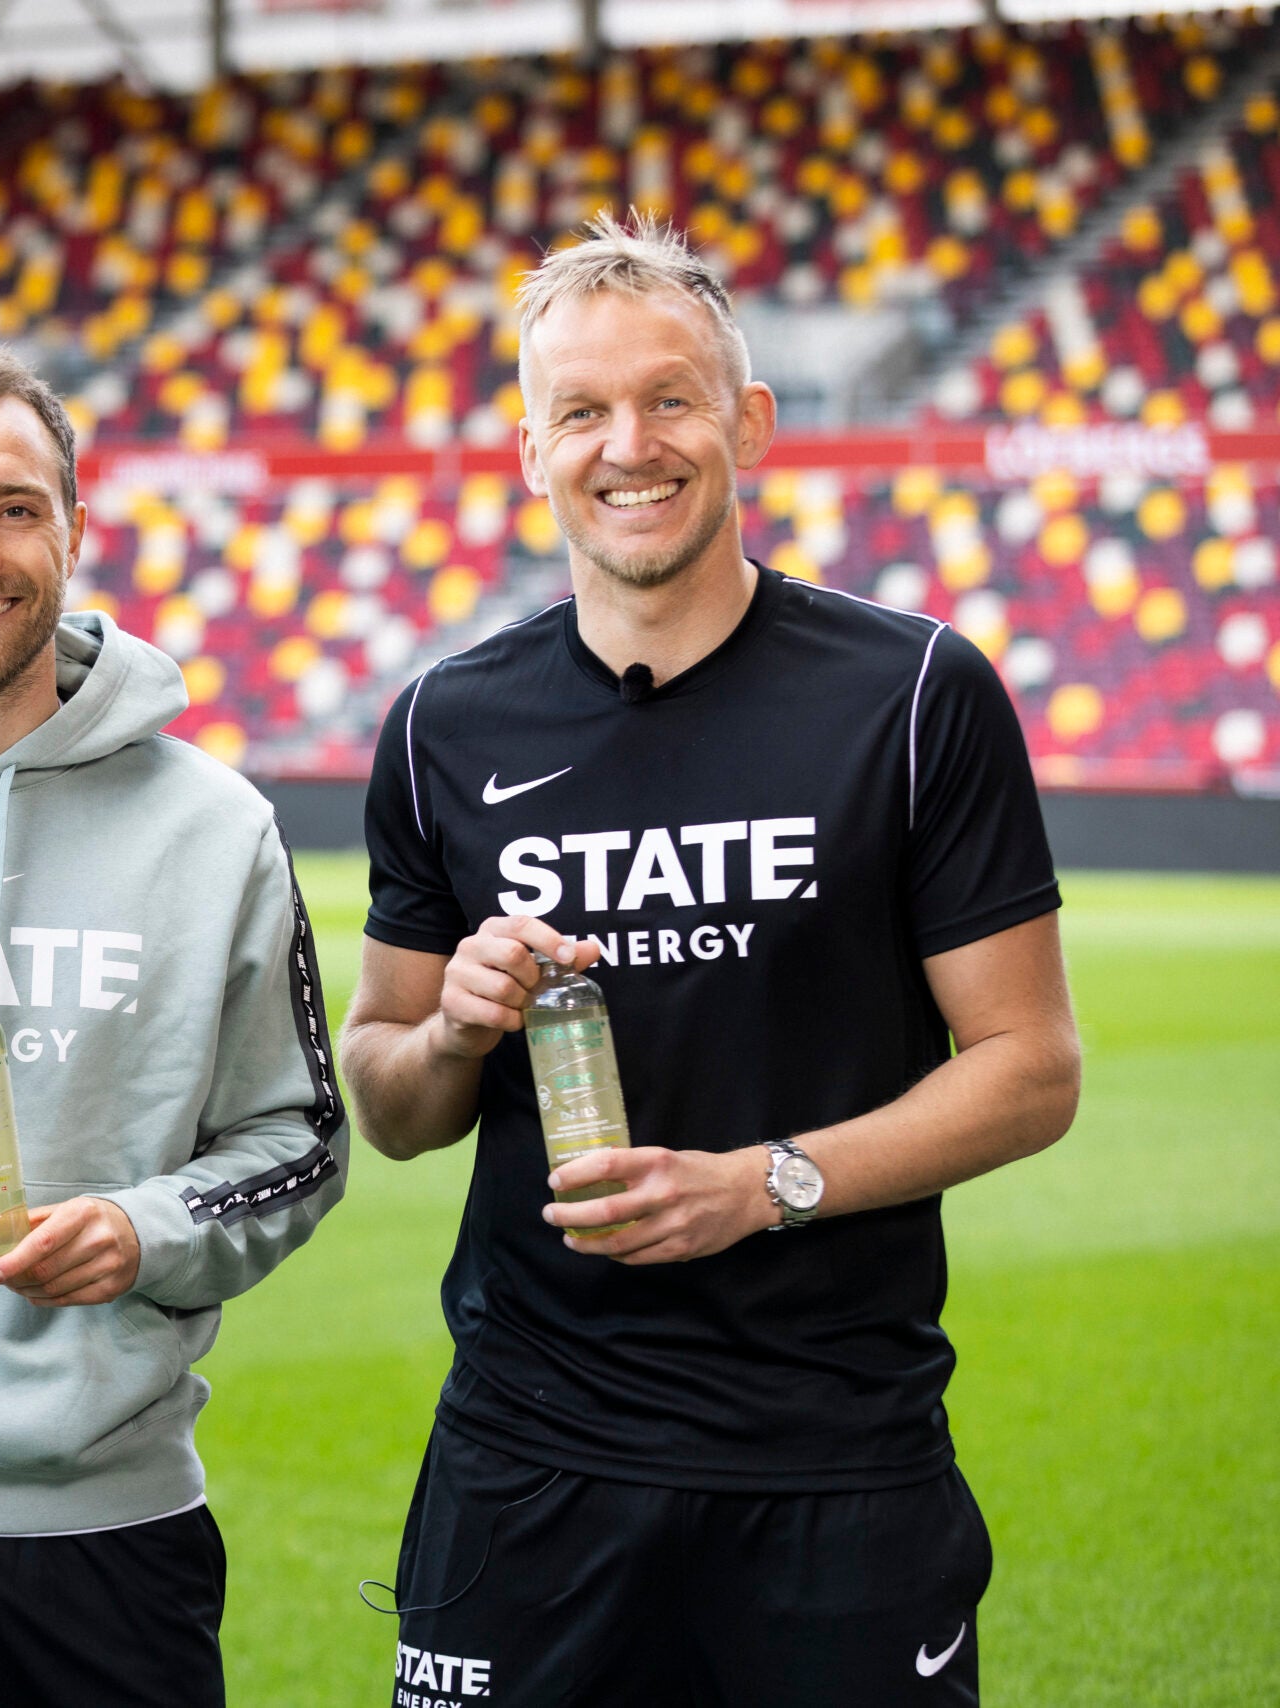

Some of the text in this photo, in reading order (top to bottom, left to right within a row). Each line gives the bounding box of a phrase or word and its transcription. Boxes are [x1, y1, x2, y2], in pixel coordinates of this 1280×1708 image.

[497, 816, 818, 918] STATE
[562, 923, 755, 967] NERGY
[395, 1640, 491, 1696] STATE
